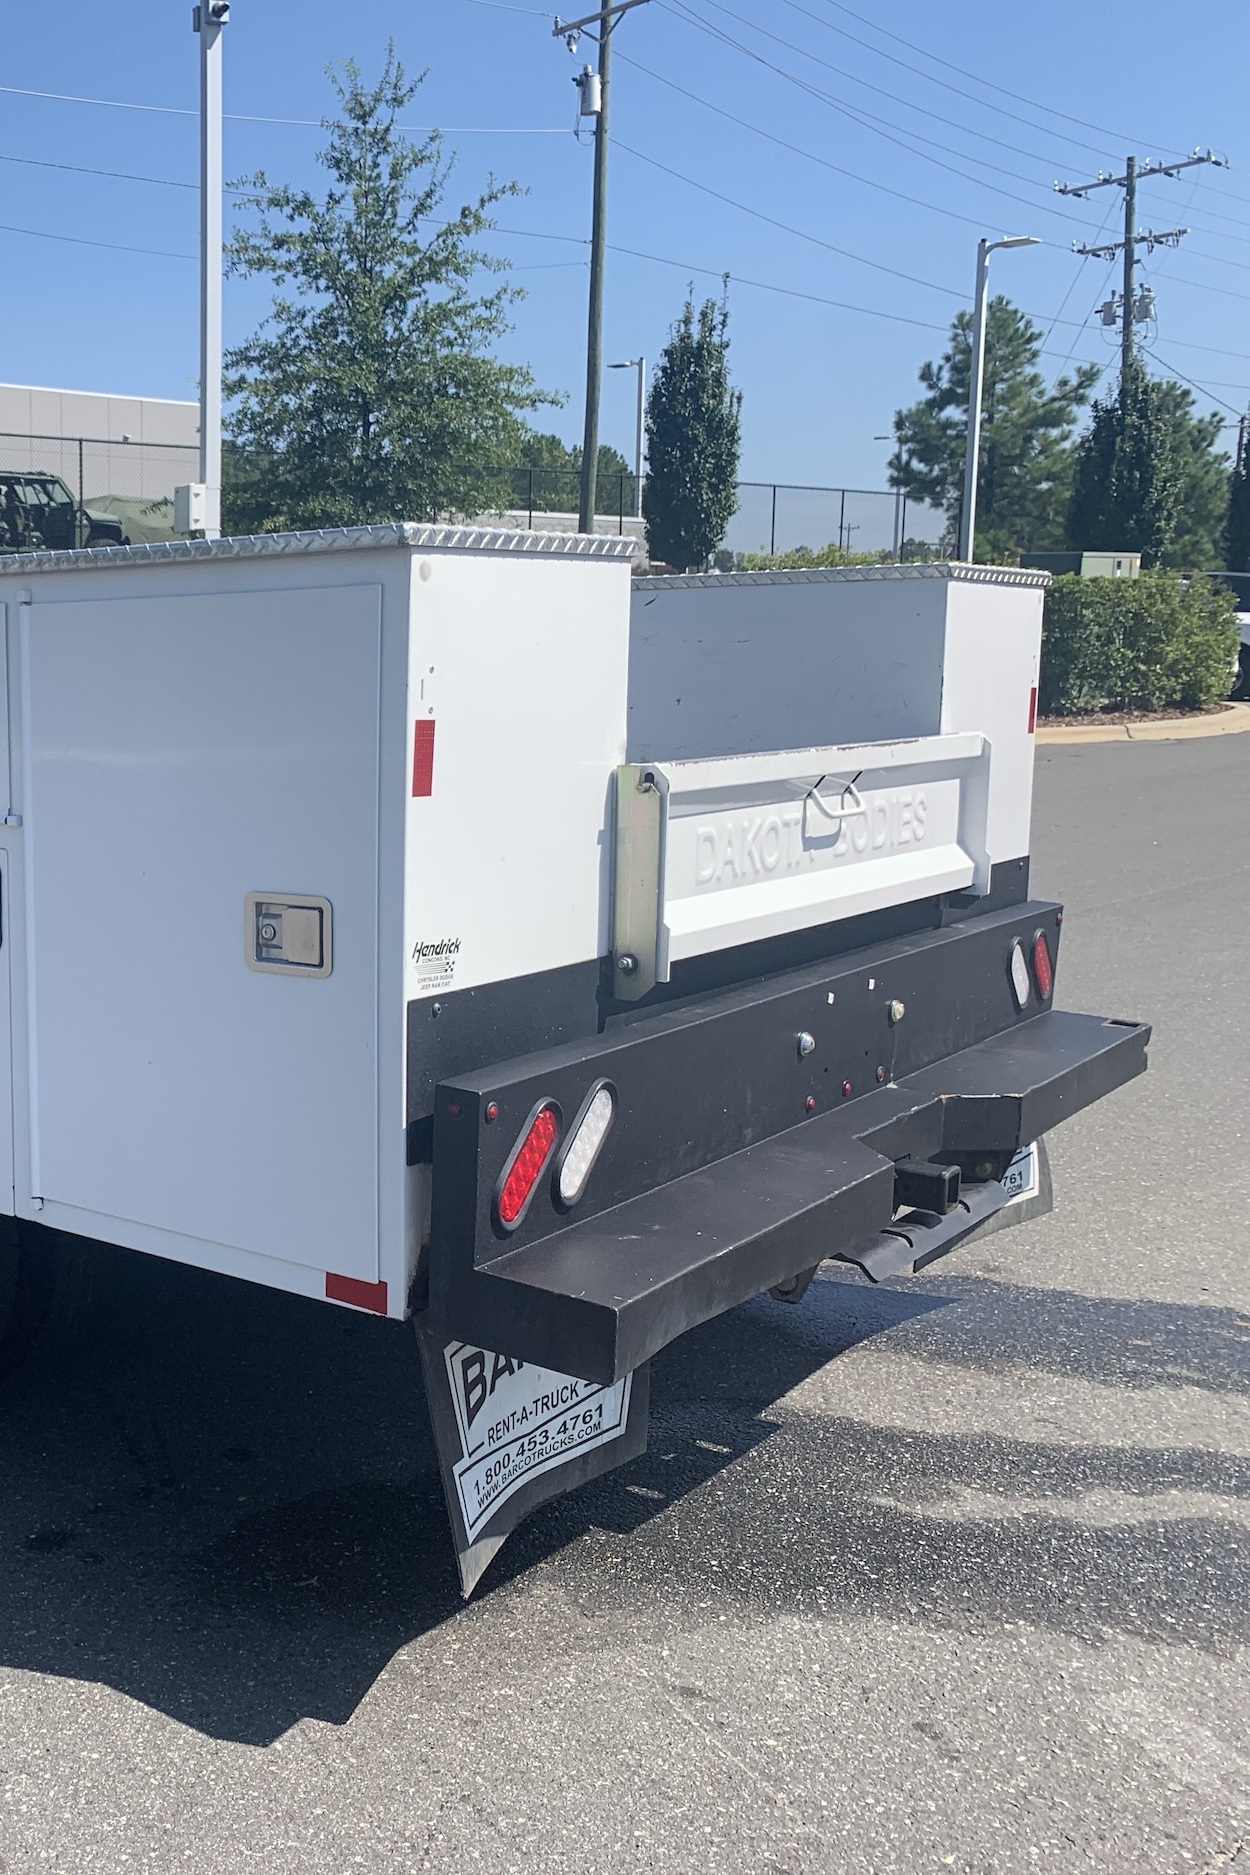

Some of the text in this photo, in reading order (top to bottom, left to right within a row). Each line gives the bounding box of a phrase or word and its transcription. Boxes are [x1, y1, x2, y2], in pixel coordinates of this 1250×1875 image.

[695, 815, 815, 886] DAKOT
[412, 937, 461, 963] Hendrick
[417, 973, 454, 984] CHRYSLER DODGE
[420, 983, 431, 991] JEEP
[487, 1381, 580, 1448] RENT-A-TRUCK
[473, 1403, 604, 1497] 1.800.453.4761
[477, 1421, 602, 1509] WWW.BARCOTRUCKS.COM
